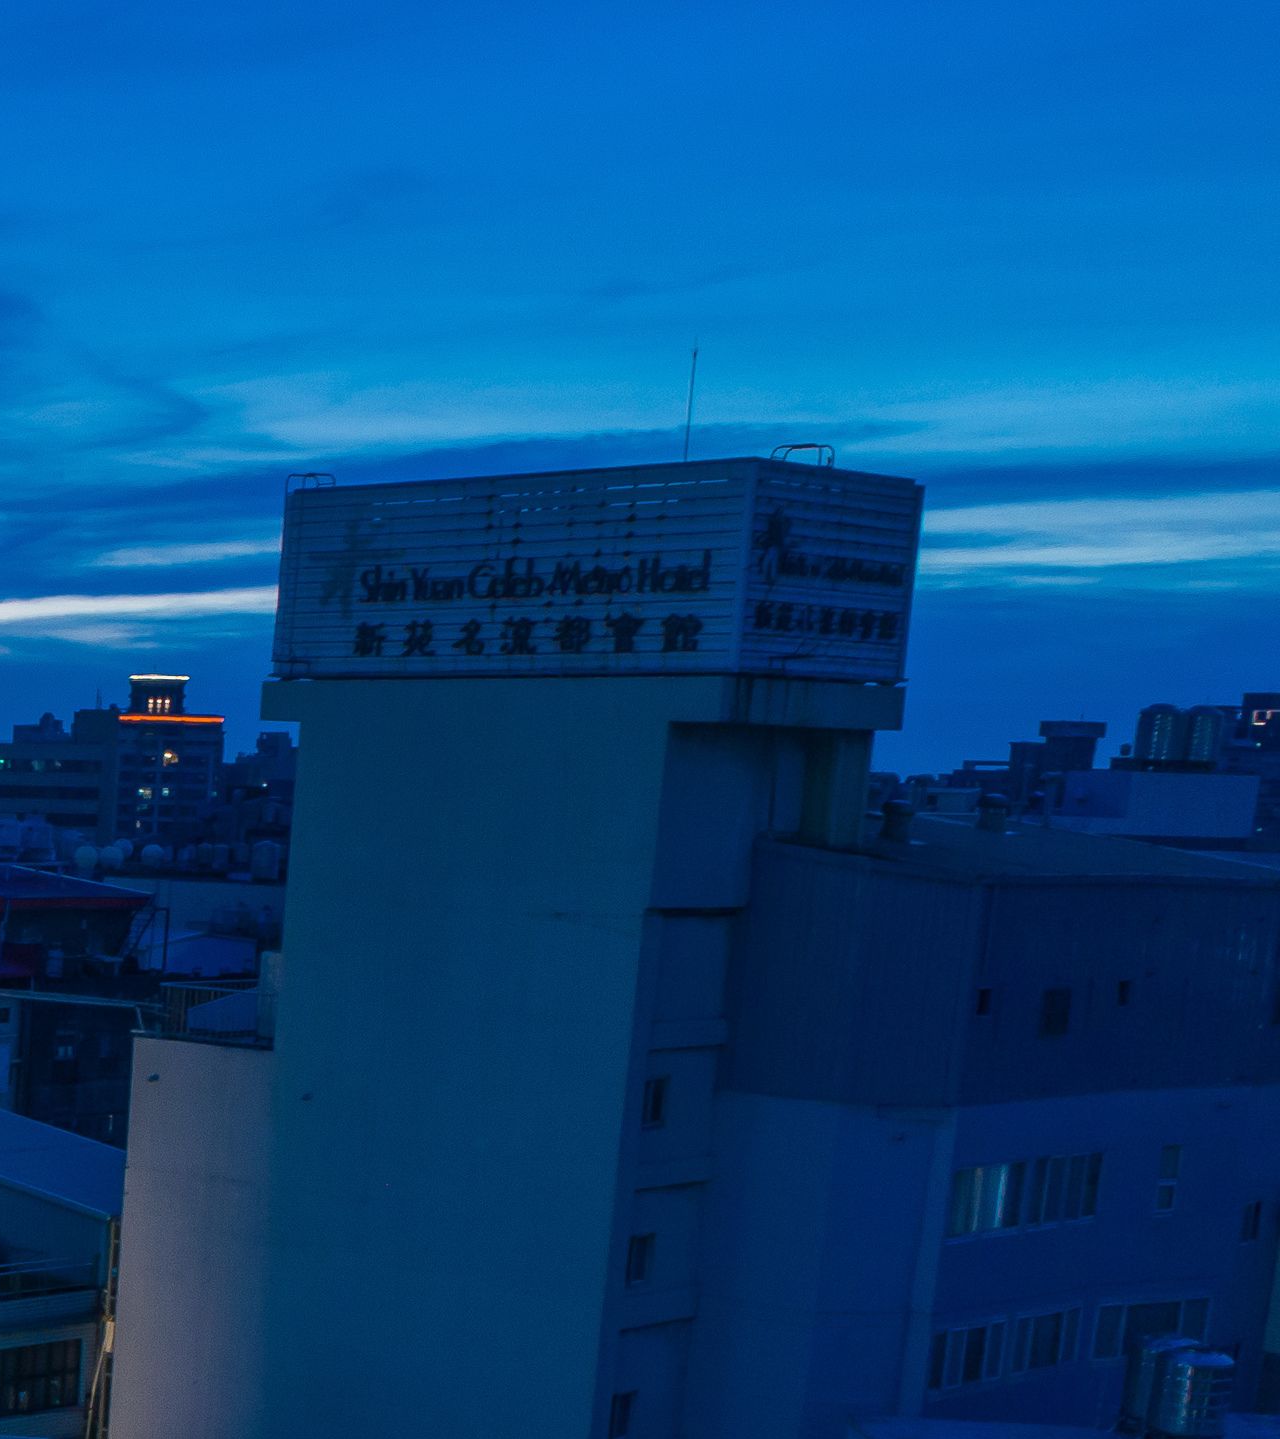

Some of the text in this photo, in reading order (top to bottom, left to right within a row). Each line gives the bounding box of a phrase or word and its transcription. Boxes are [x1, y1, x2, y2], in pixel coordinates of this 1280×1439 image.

[358, 565, 405, 604] Shin
[408, 567, 464, 602] Yuan
[636, 549, 713, 594] Hotel
